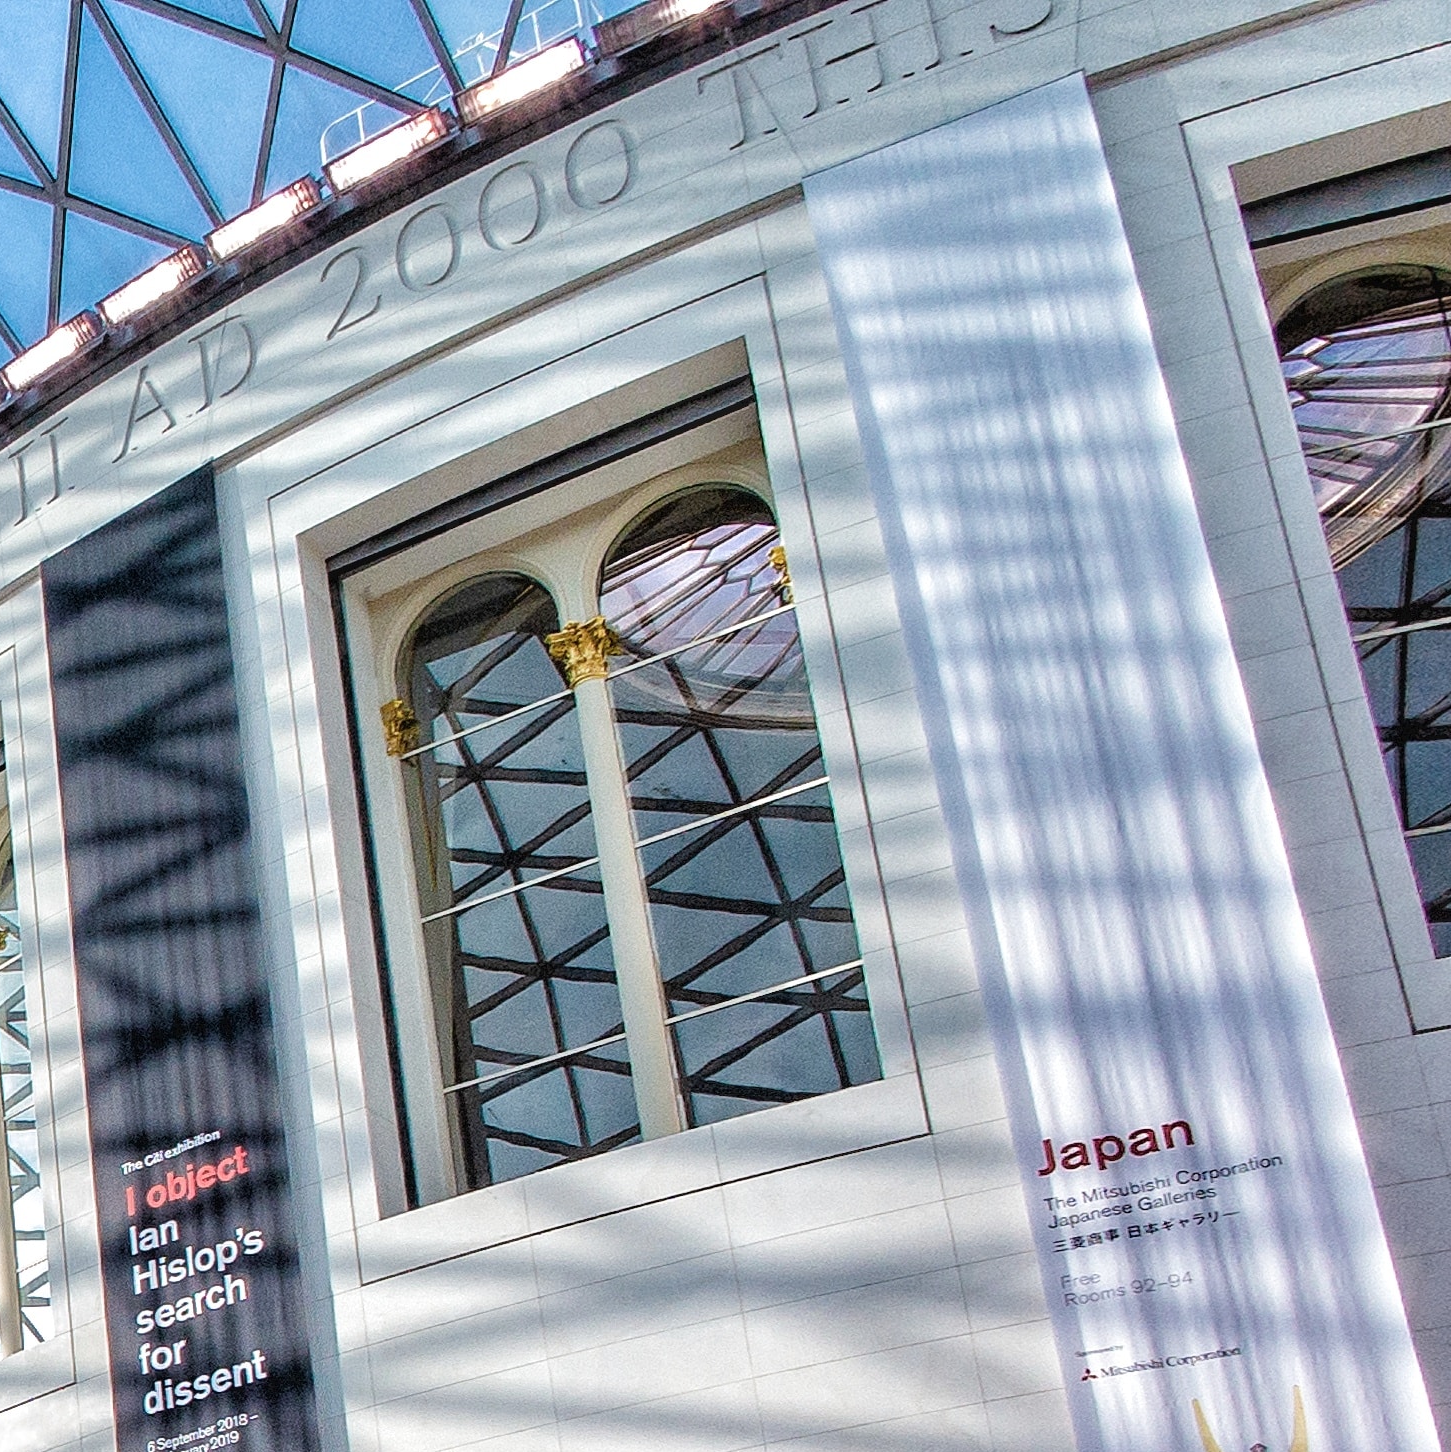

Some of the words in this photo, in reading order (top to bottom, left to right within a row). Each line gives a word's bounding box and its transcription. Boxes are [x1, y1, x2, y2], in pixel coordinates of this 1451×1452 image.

[112, 313, 257, 463] AD
[320, 119, 633, 341] 2000
[121, 1160, 143, 1175] The
[144, 1151, 164, 1167] Citi
[164, 1130, 221, 1158] exhibition
[1038, 1119, 1195, 1177] Japan
[126, 1186, 136, 1216] I
[146, 1146, 250, 1208] object
[1043, 1196, 1078, 1212] The
[1081, 1177, 1171, 1204] Mitsubishi
[1175, 1155, 1283, 1185] Corporation
[1047, 1202, 1133, 1229] Japanese
[1137, 1185, 1217, 1211] Galleries
[129, 1219, 179, 1256] Ian
[1060, 1273, 1101, 1290] Free
[1064, 1286, 1126, 1307] Rooms
[136, 1274, 247, 1334] search
[138, 1339, 187, 1375] for
[1101, 1357, 1164, 1378] Mitsubishi
[1166, 1347, 1242, 1367] Corporation
[143, 1350, 268, 1415] dissent
[156, 1425, 216, 1450] September
[217, 1413, 248, 1432] 2018
[210, 1430, 239, 1450] 2019
